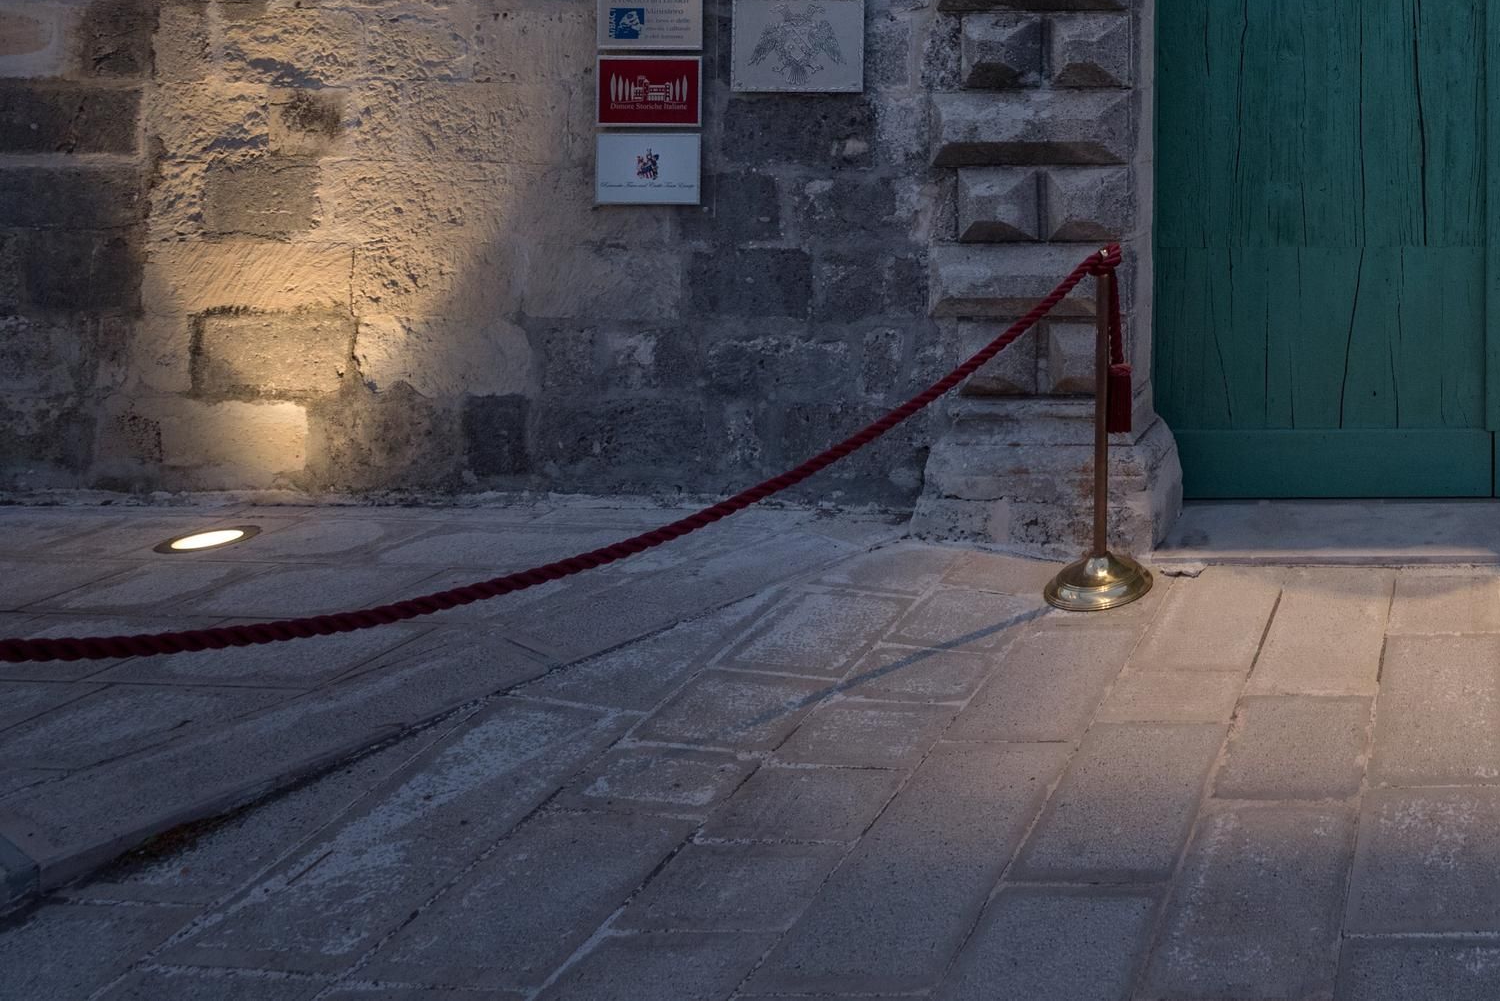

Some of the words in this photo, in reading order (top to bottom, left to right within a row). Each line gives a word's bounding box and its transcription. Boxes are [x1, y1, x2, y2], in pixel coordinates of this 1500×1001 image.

[610, 102, 635, 110] Dimore
[635, 102, 663, 110] Storiche
[663, 102, 688, 110] Italiane
